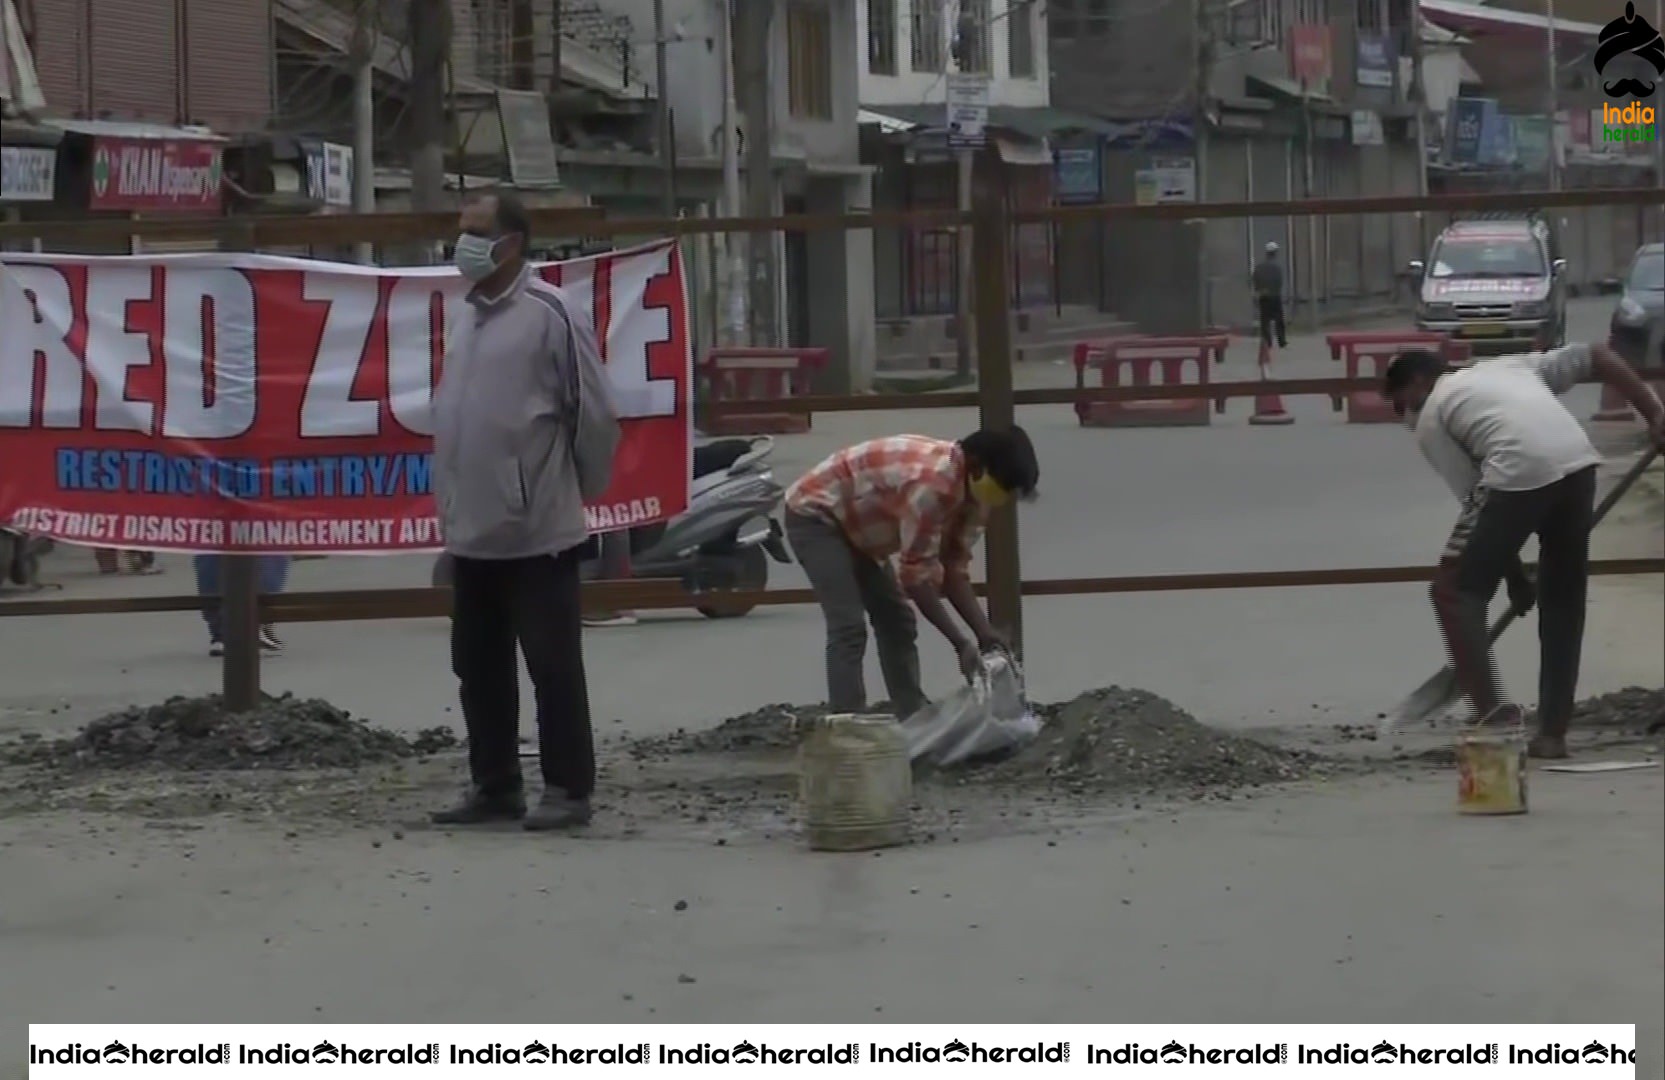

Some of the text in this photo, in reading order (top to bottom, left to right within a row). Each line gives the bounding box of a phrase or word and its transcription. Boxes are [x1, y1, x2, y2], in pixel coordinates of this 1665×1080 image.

[0, 262, 257, 439] RED
[11, 507, 118, 538] DISTRICT
[123, 515, 225, 544] DISASTER
[231, 519, 393, 545] MANAGEMENT
